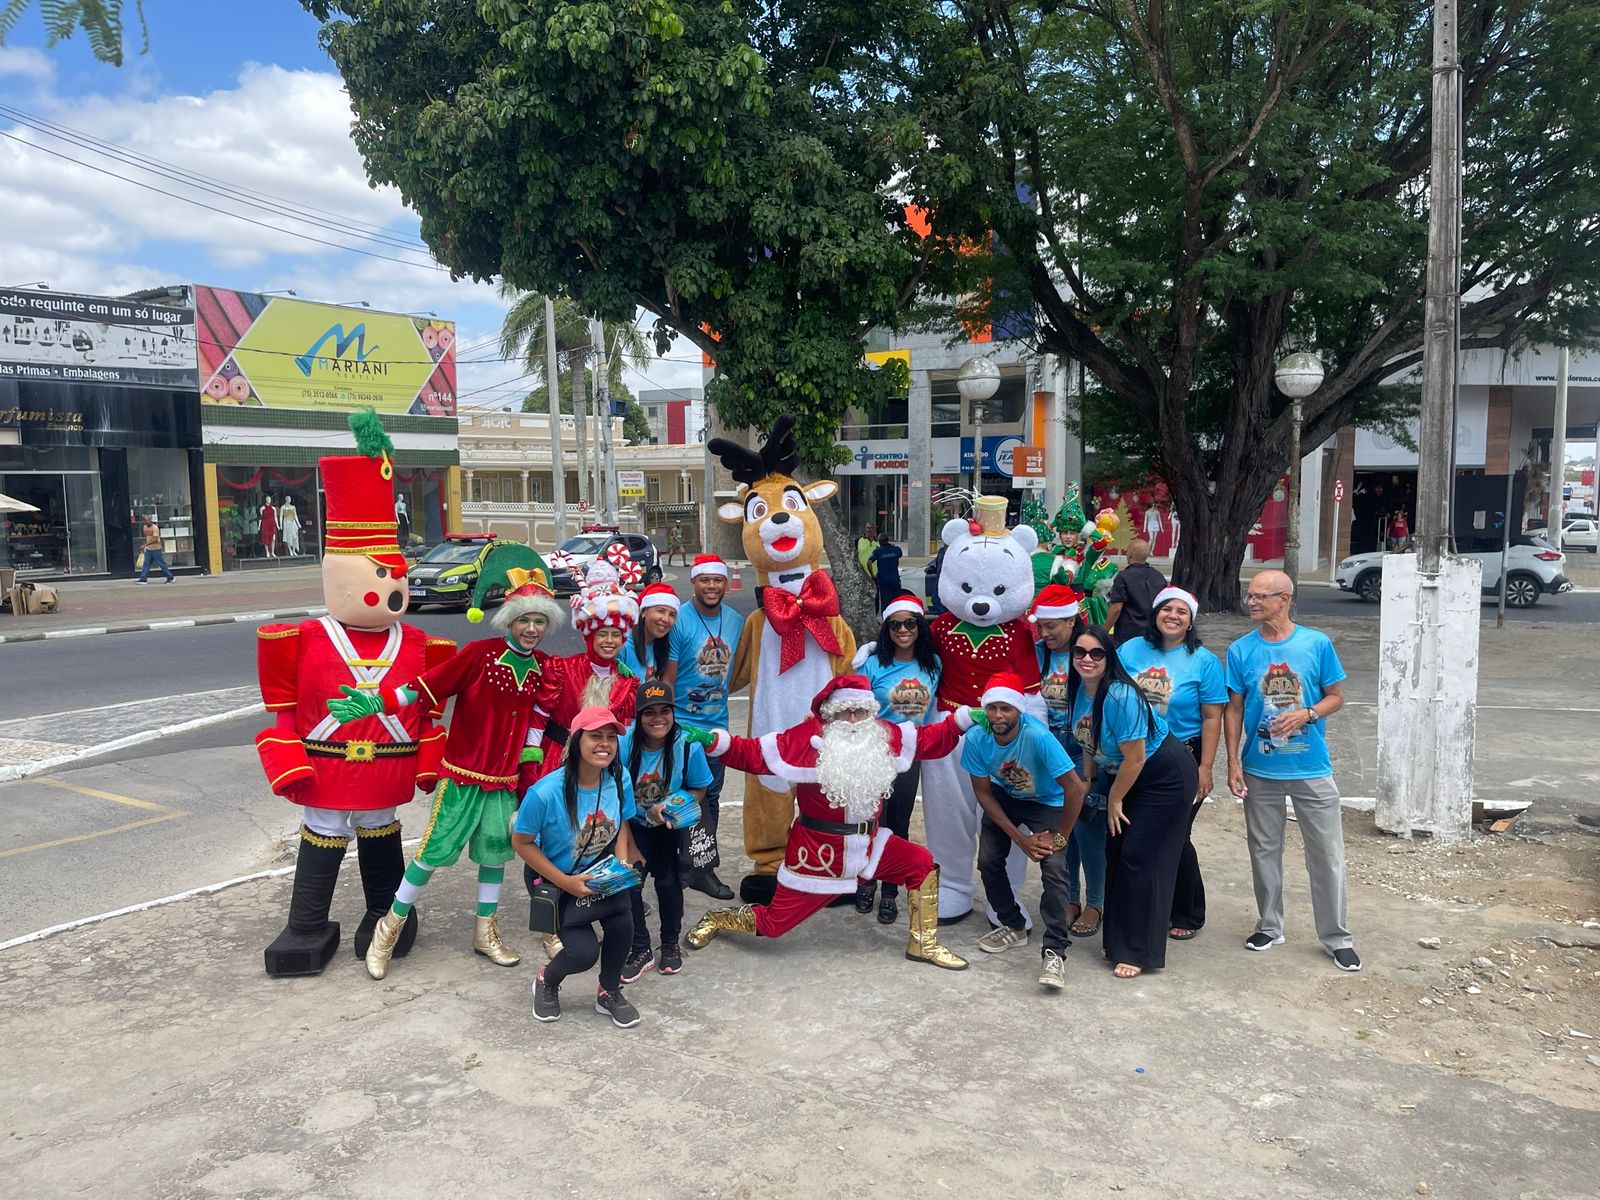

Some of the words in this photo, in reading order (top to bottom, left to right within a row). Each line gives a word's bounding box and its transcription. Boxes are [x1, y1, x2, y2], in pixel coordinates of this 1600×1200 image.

[0, 295, 26, 307] odo
[30, 297, 85, 312] requinte
[88, 304, 109, 315] em
[112, 306, 131, 317] um
[135, 308, 149, 319] só
[152, 309, 182, 324] lugar
[0, 364, 14, 374] ias
[17, 365, 51, 376] Primas
[63, 368, 120, 380] Embalagens
[319, 358, 387, 375] MARIANI
[0, 406, 83, 424] rfumista
